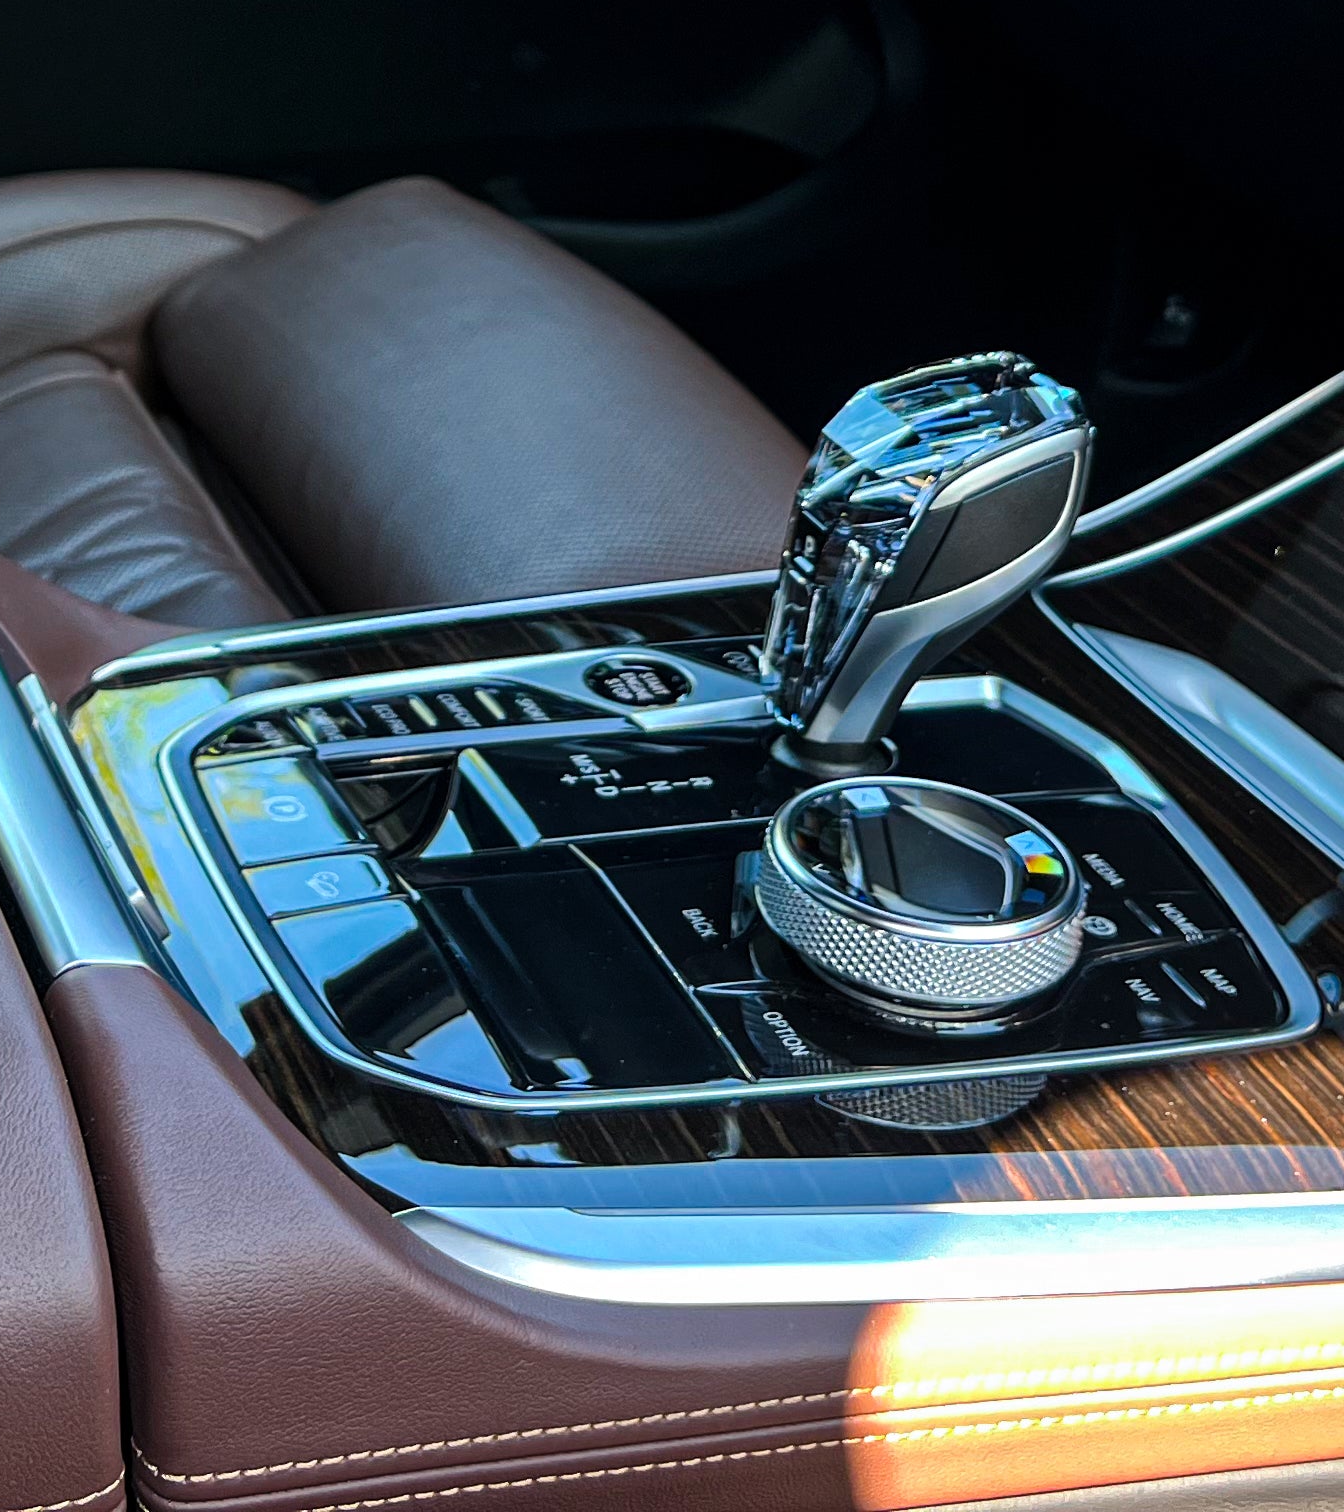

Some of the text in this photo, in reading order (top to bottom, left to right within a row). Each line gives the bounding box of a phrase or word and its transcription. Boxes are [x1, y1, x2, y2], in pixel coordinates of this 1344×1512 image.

[371, 703, 399, 720] ECO
[436, 693, 482, 727] COMFORT
[646, 780, 674, 793] N
[1082, 853, 1126, 888] MEDIA
[681, 908, 719, 938] BACK
[1125, 978, 1162, 1003] NAV
[1200, 968, 1238, 997] MAP
[762, 1011, 811, 1057] OPTION
